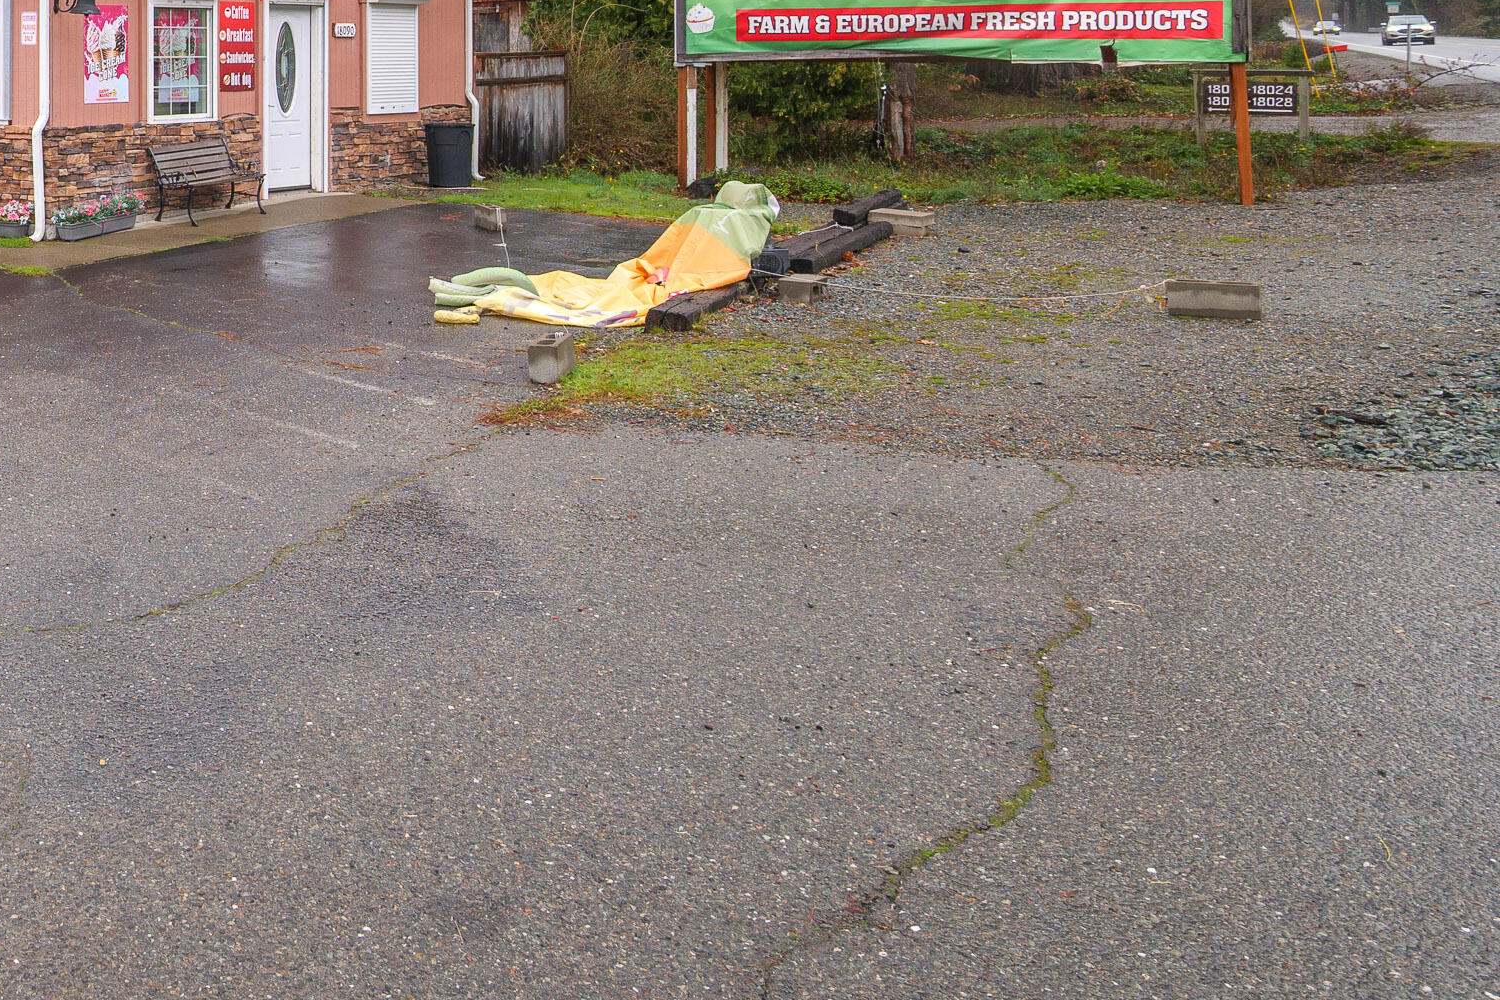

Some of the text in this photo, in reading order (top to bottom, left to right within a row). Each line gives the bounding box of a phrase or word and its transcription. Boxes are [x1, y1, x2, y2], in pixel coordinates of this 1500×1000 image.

[231, 5, 250, 19] Coffee
[748, 8, 1208, 35] FARM & EUROPEAN FRESH PRODUCTS
[226, 27, 254, 42] Breakfast
[101, 52, 126, 69] CREAM
[230, 72, 252, 88] Hot dog
